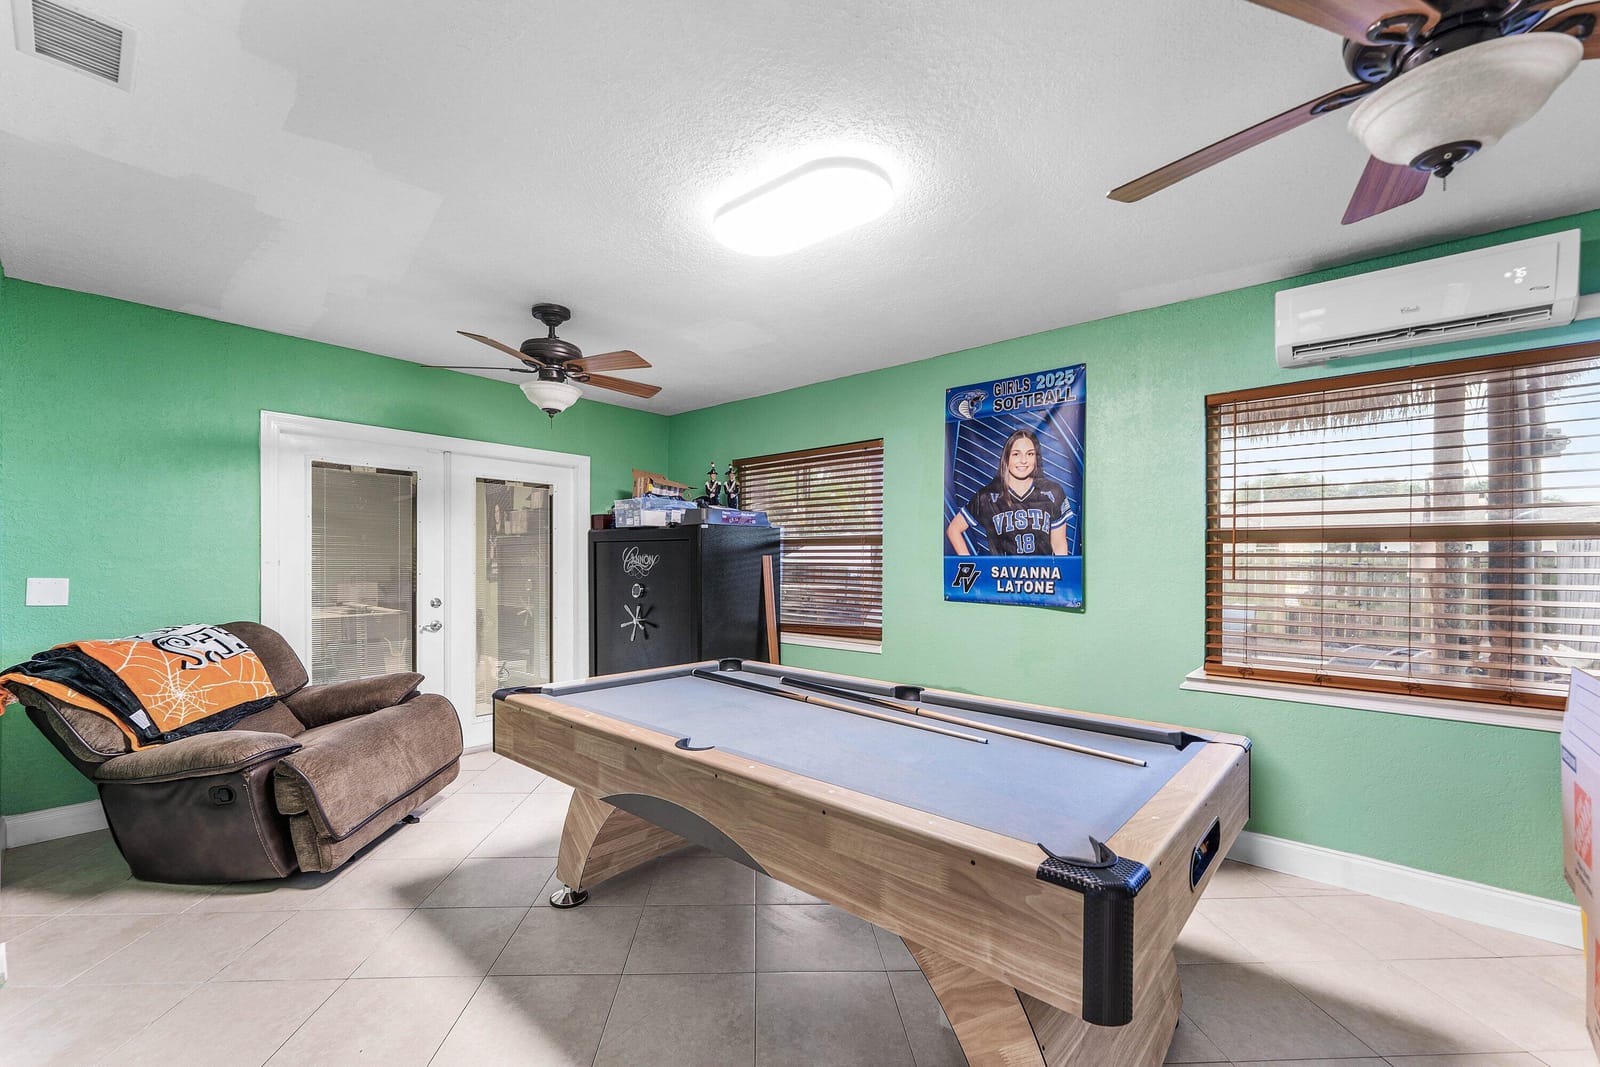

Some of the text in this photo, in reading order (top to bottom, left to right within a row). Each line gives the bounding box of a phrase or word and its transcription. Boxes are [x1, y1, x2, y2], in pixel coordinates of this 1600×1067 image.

[993, 369, 1075, 397] GIRLS 2025
[993, 387, 1076, 413] SOFTBALL
[1014, 533, 1035, 554] 18
[991, 566, 1061, 580] SAVANNA
[996, 580, 1054, 594] LATONE
